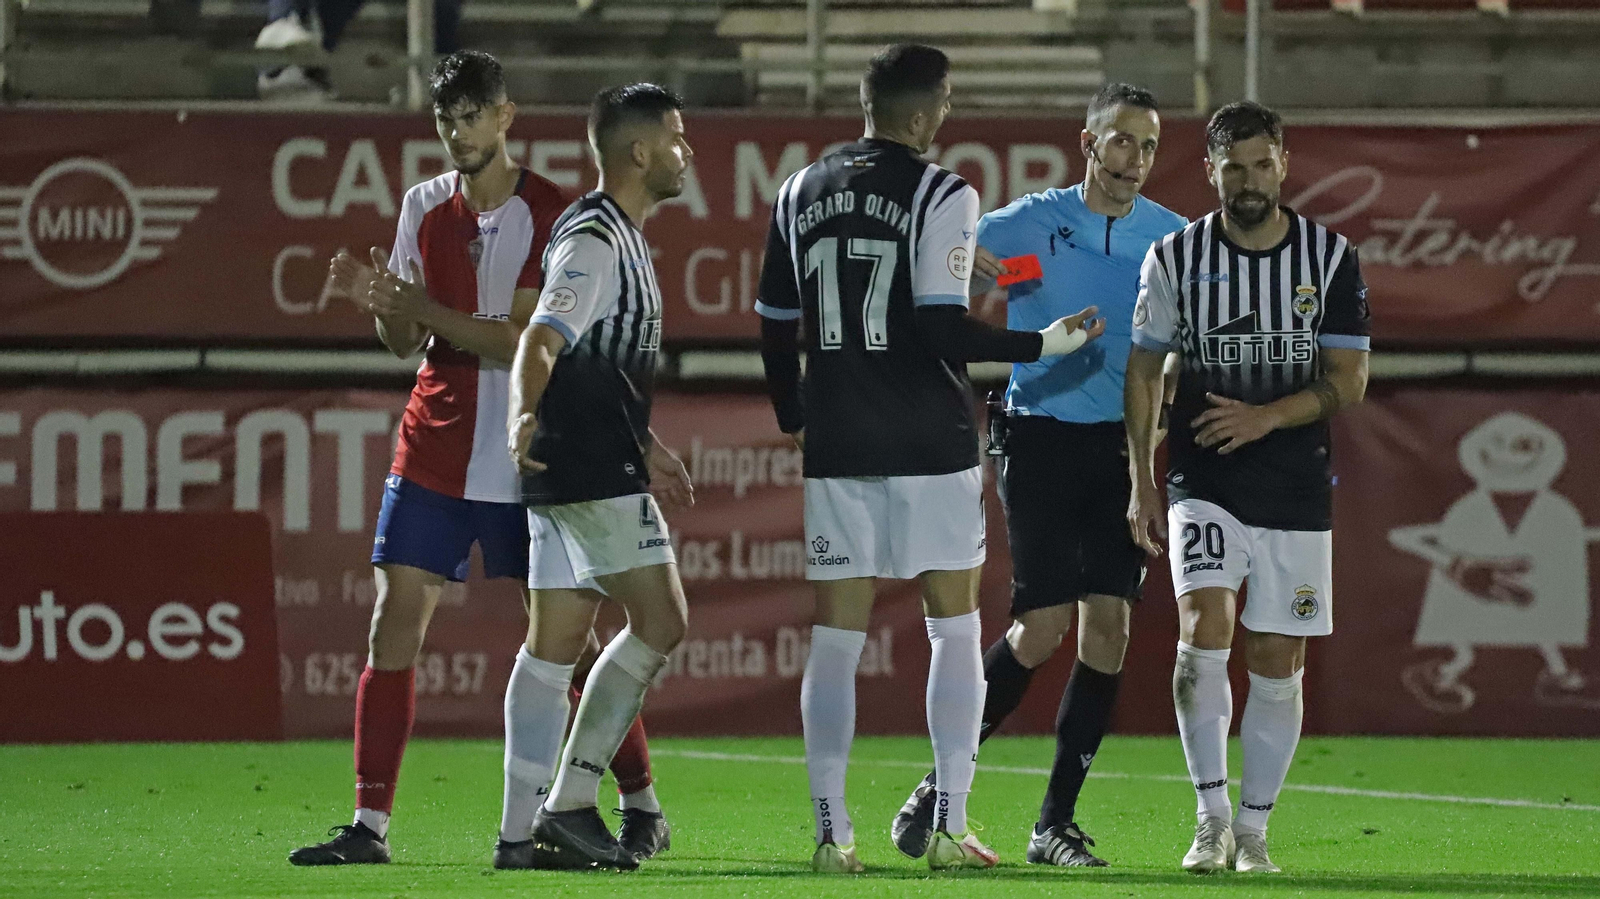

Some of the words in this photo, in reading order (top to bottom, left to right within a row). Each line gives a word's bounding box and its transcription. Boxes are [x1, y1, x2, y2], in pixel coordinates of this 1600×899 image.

[36, 206, 127, 241] MINI
[797, 190, 855, 235] GERARD
[864, 193, 911, 236] OLIVA
[804, 236, 898, 350] 17
[1202, 339, 1313, 364] LOTUS
[818, 554, 850, 566] Galán
[1181, 521, 1225, 564] 20
[1183, 562, 1224, 575] LEGEA
[451, 651, 489, 695] 57
